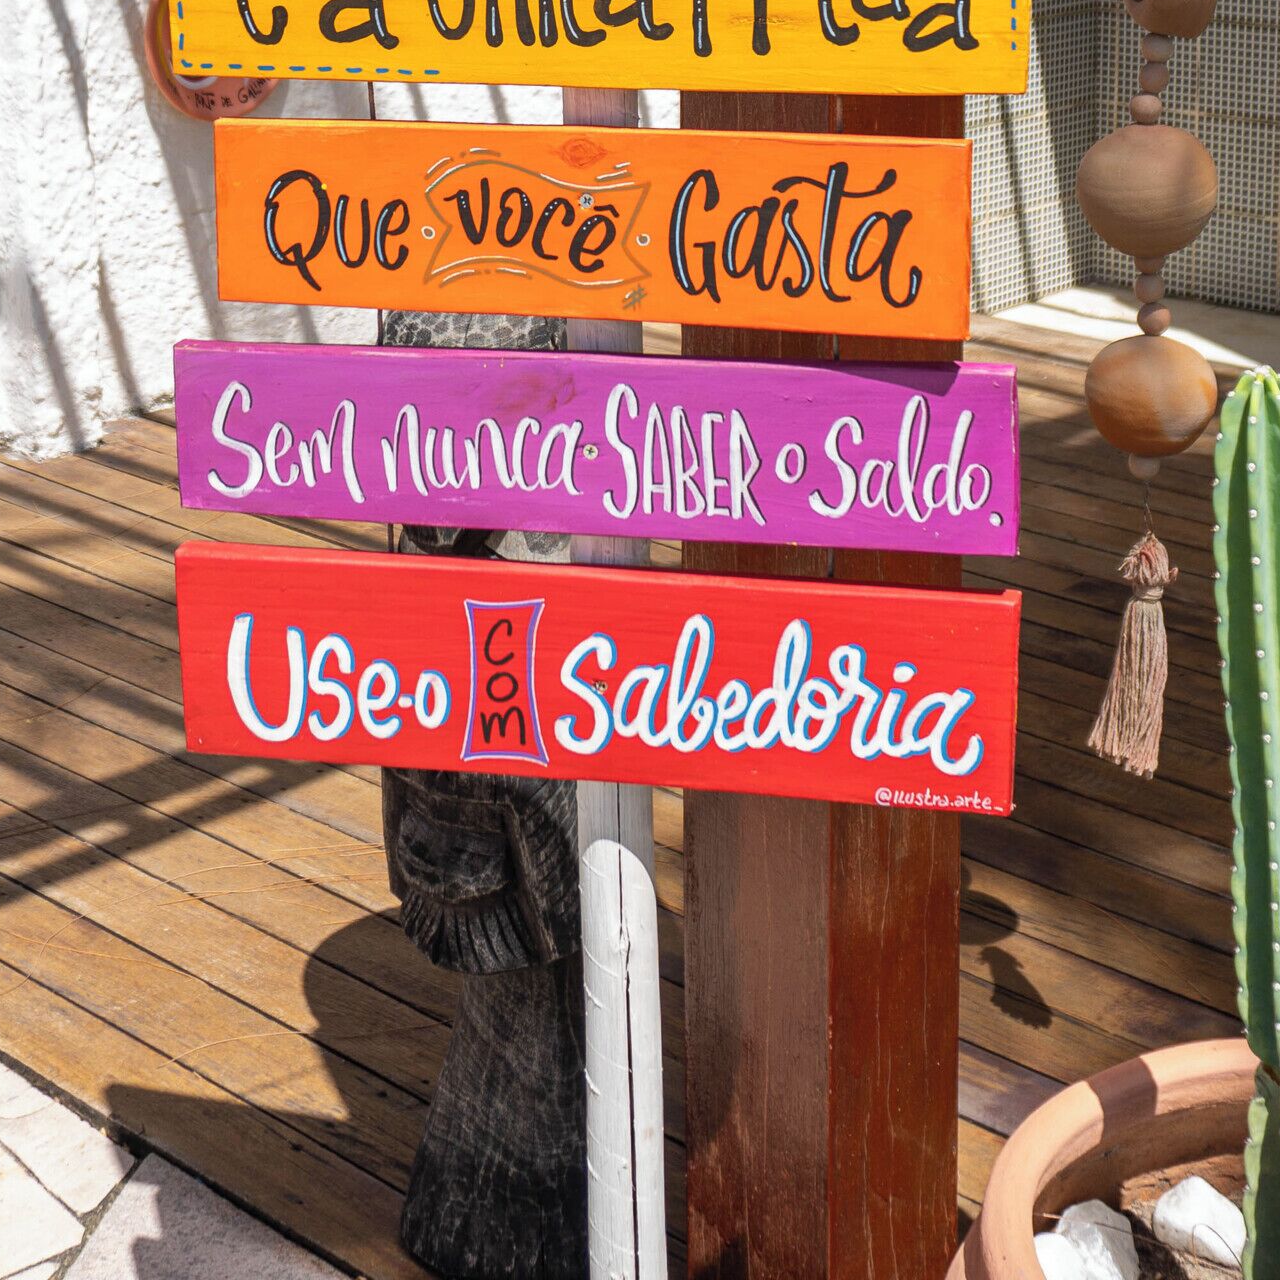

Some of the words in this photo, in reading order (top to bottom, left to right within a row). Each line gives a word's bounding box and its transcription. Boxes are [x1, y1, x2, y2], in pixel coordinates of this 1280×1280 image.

[263, 168, 411, 292] Que
[444, 177, 623, 272] você
[668, 160, 923, 308] Gasta
[207, 378, 366, 507] Sem
[380, 394, 585, 498] nunca
[602, 382, 768, 527] SABER
[775, 442, 808, 487] o
[554, 612, 984, 778] Sabedoria
